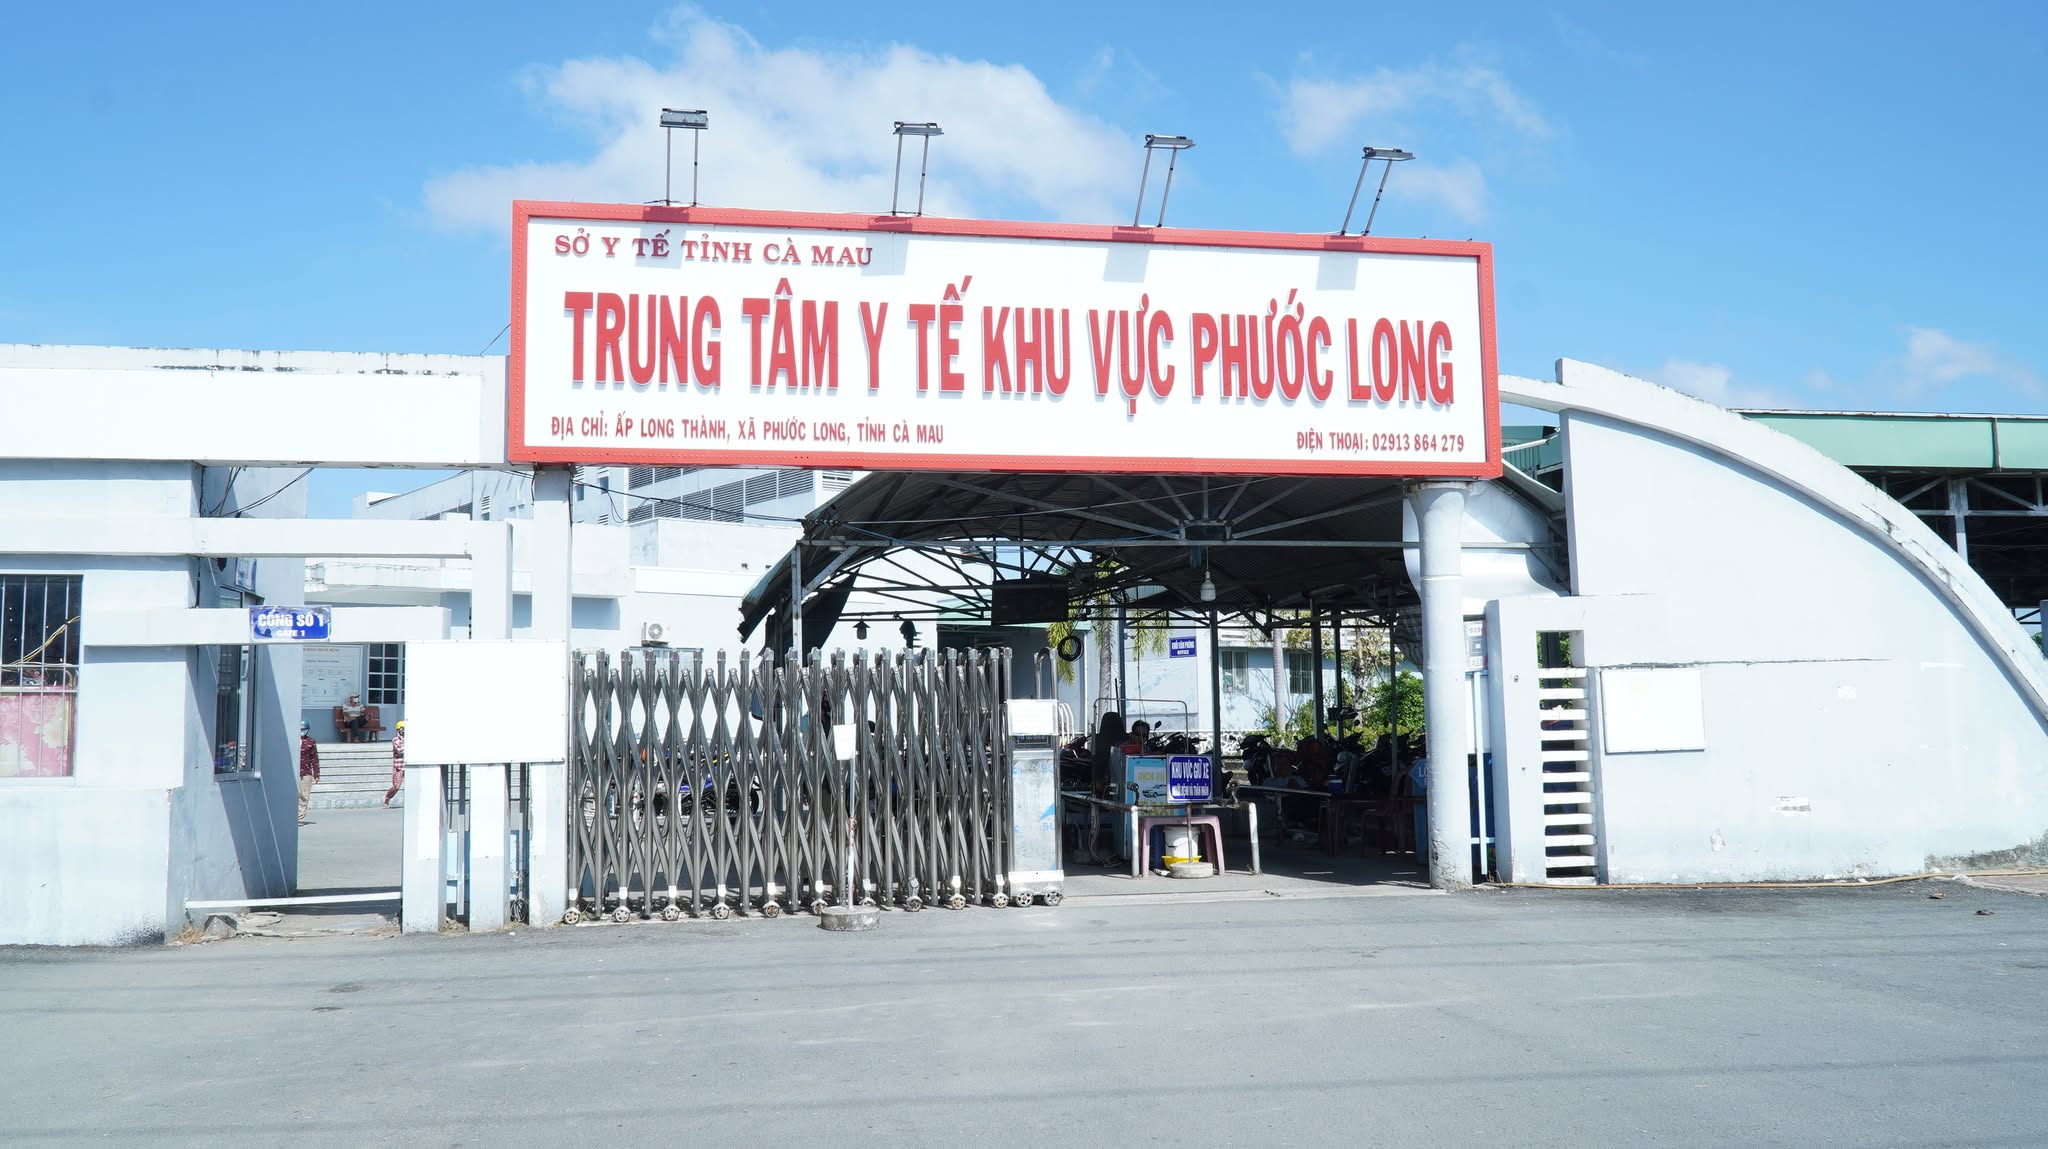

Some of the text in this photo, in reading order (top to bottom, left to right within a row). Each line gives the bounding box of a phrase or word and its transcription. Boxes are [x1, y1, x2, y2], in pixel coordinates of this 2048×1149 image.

[555, 228, 873, 266] SỞ Y TẾ TỈNH CÀ MAU
[564, 275, 1454, 416] TRUNG TÂM Y TẾ KHU VỰC PHƯỚC LONG
[551, 410, 944, 445] ĐỊA CHỈ: ẤP LONG THÀNH, XÃ PHƯỚC LONG, TỈNH CÀ MAU
[1297, 427, 1464, 454] ĐIỆN THOẠI: 02913 864 279
[318, 613, 324, 627] 1
[1171, 761, 1182, 779] KHU
[1183, 759, 1193, 782] VỰC
[1203, 762, 1209, 779] XE
